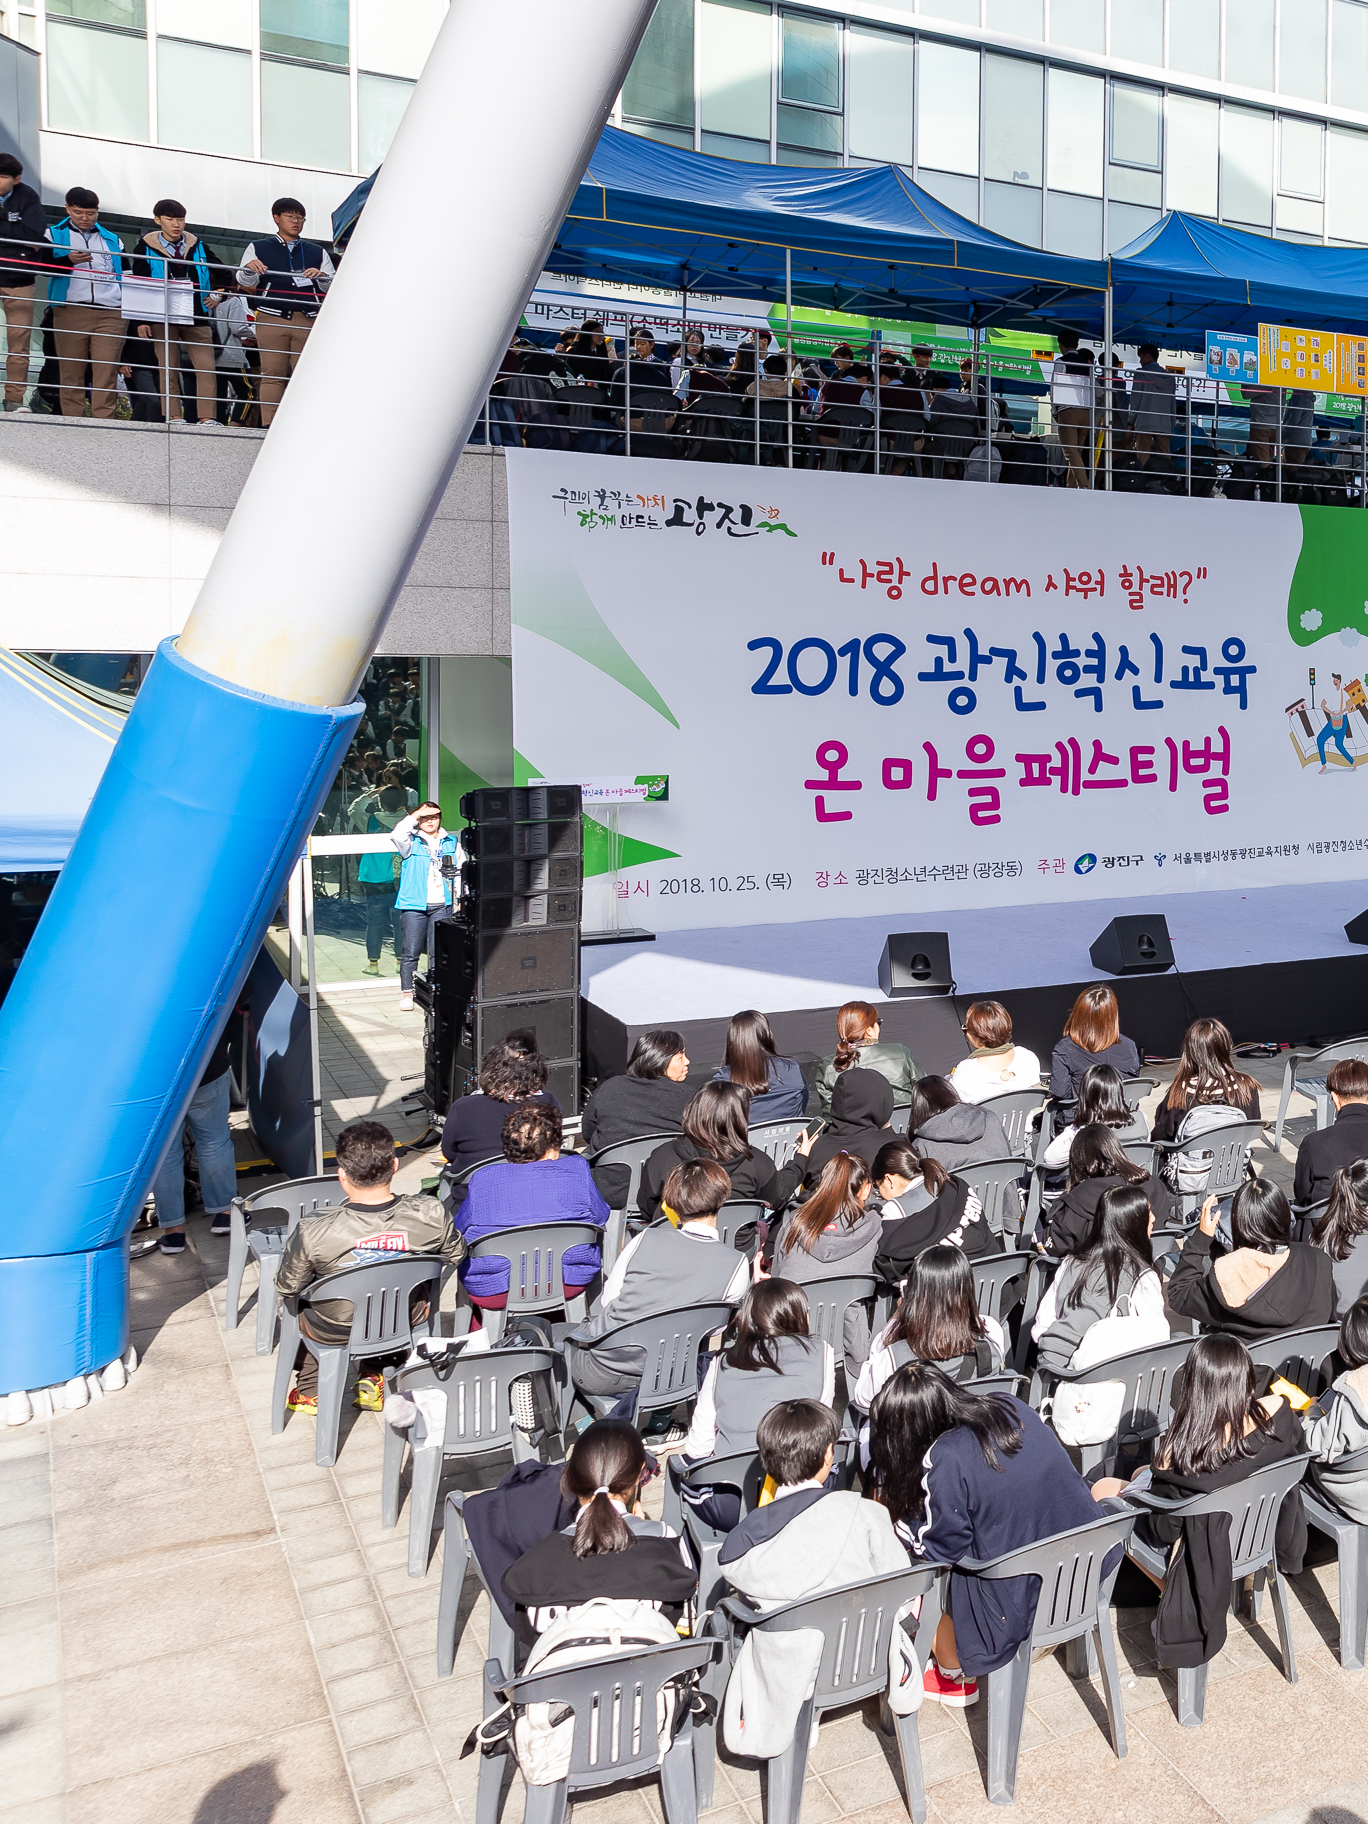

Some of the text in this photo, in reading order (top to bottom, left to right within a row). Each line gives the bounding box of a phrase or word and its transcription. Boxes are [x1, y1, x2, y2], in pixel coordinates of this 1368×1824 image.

[636, 494, 666, 512] 가치
[664, 495, 760, 538] 광진
[576, 508, 662, 532] 함께 만드는
[821, 551, 1209, 611] "나랑 dream 샤워 할래?"
[747, 627, 1259, 716] 2018 광진혁신교육
[804, 739, 864, 825] 온
[815, 861, 1024, 889] 장소 광진청소년수련관 (광장동)
[1037, 858, 1066, 875] 주관
[1101, 854, 1145, 869] 광진구
[1172, 843, 1301, 865] 서울특별시성동광진교육지원청
[613, 872, 793, 899] 일시 2018. 10. 25. (목)
